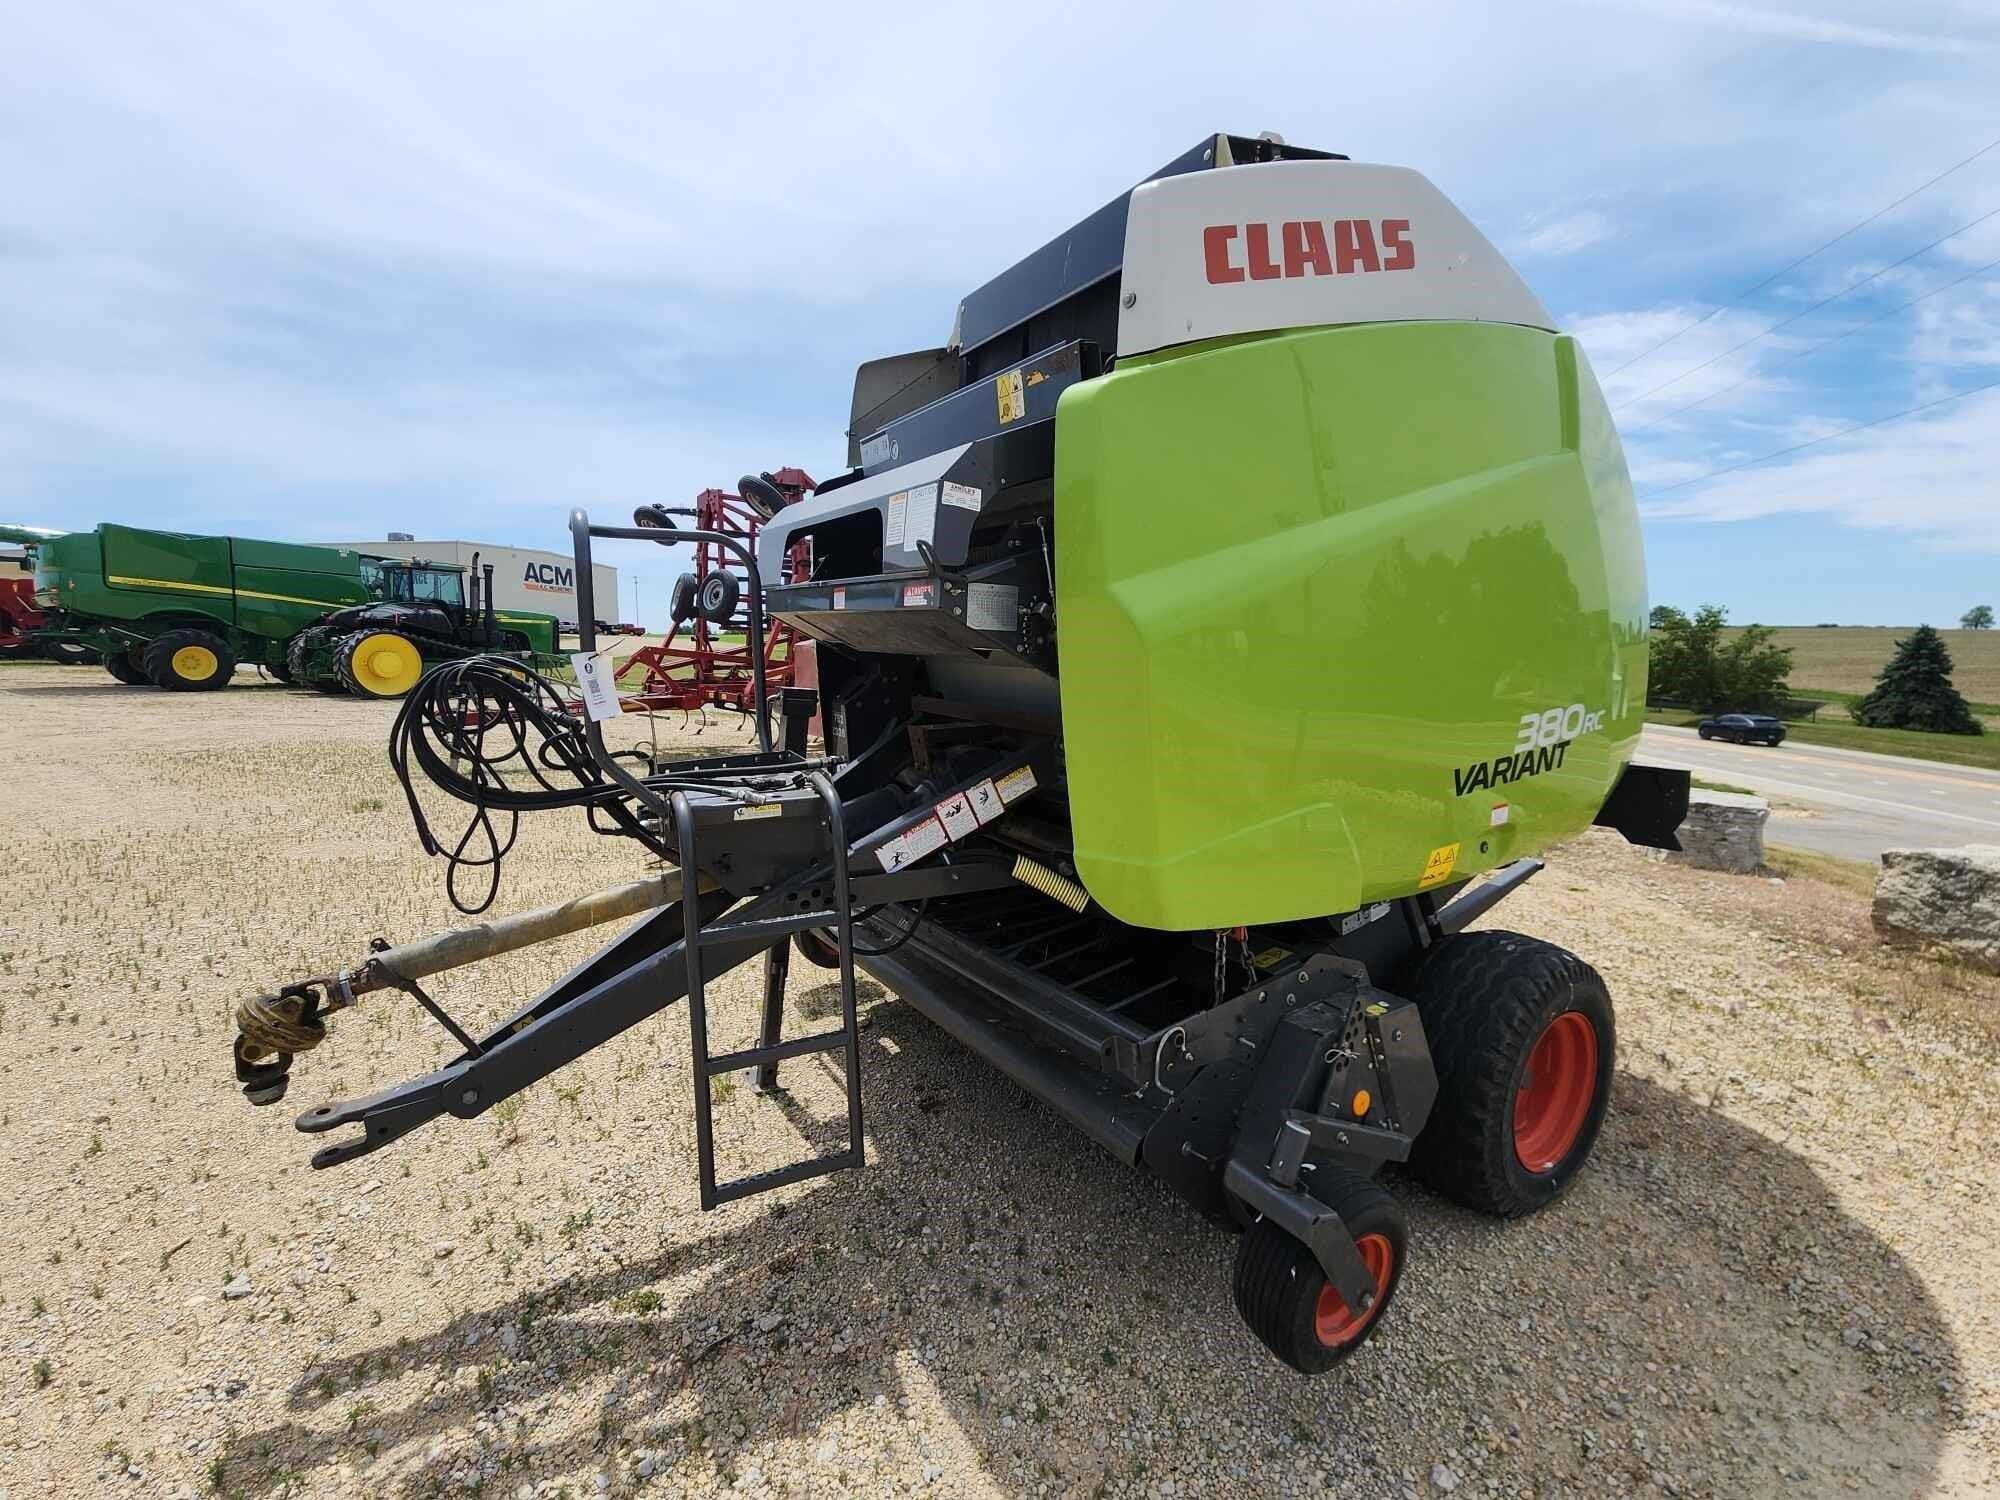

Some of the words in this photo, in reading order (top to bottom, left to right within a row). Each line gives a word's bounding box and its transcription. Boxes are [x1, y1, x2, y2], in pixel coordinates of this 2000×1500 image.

[1204, 219, 1415, 284] CLAAS
[524, 562, 573, 586] ACM
[1454, 740, 1571, 796] VARIANT
